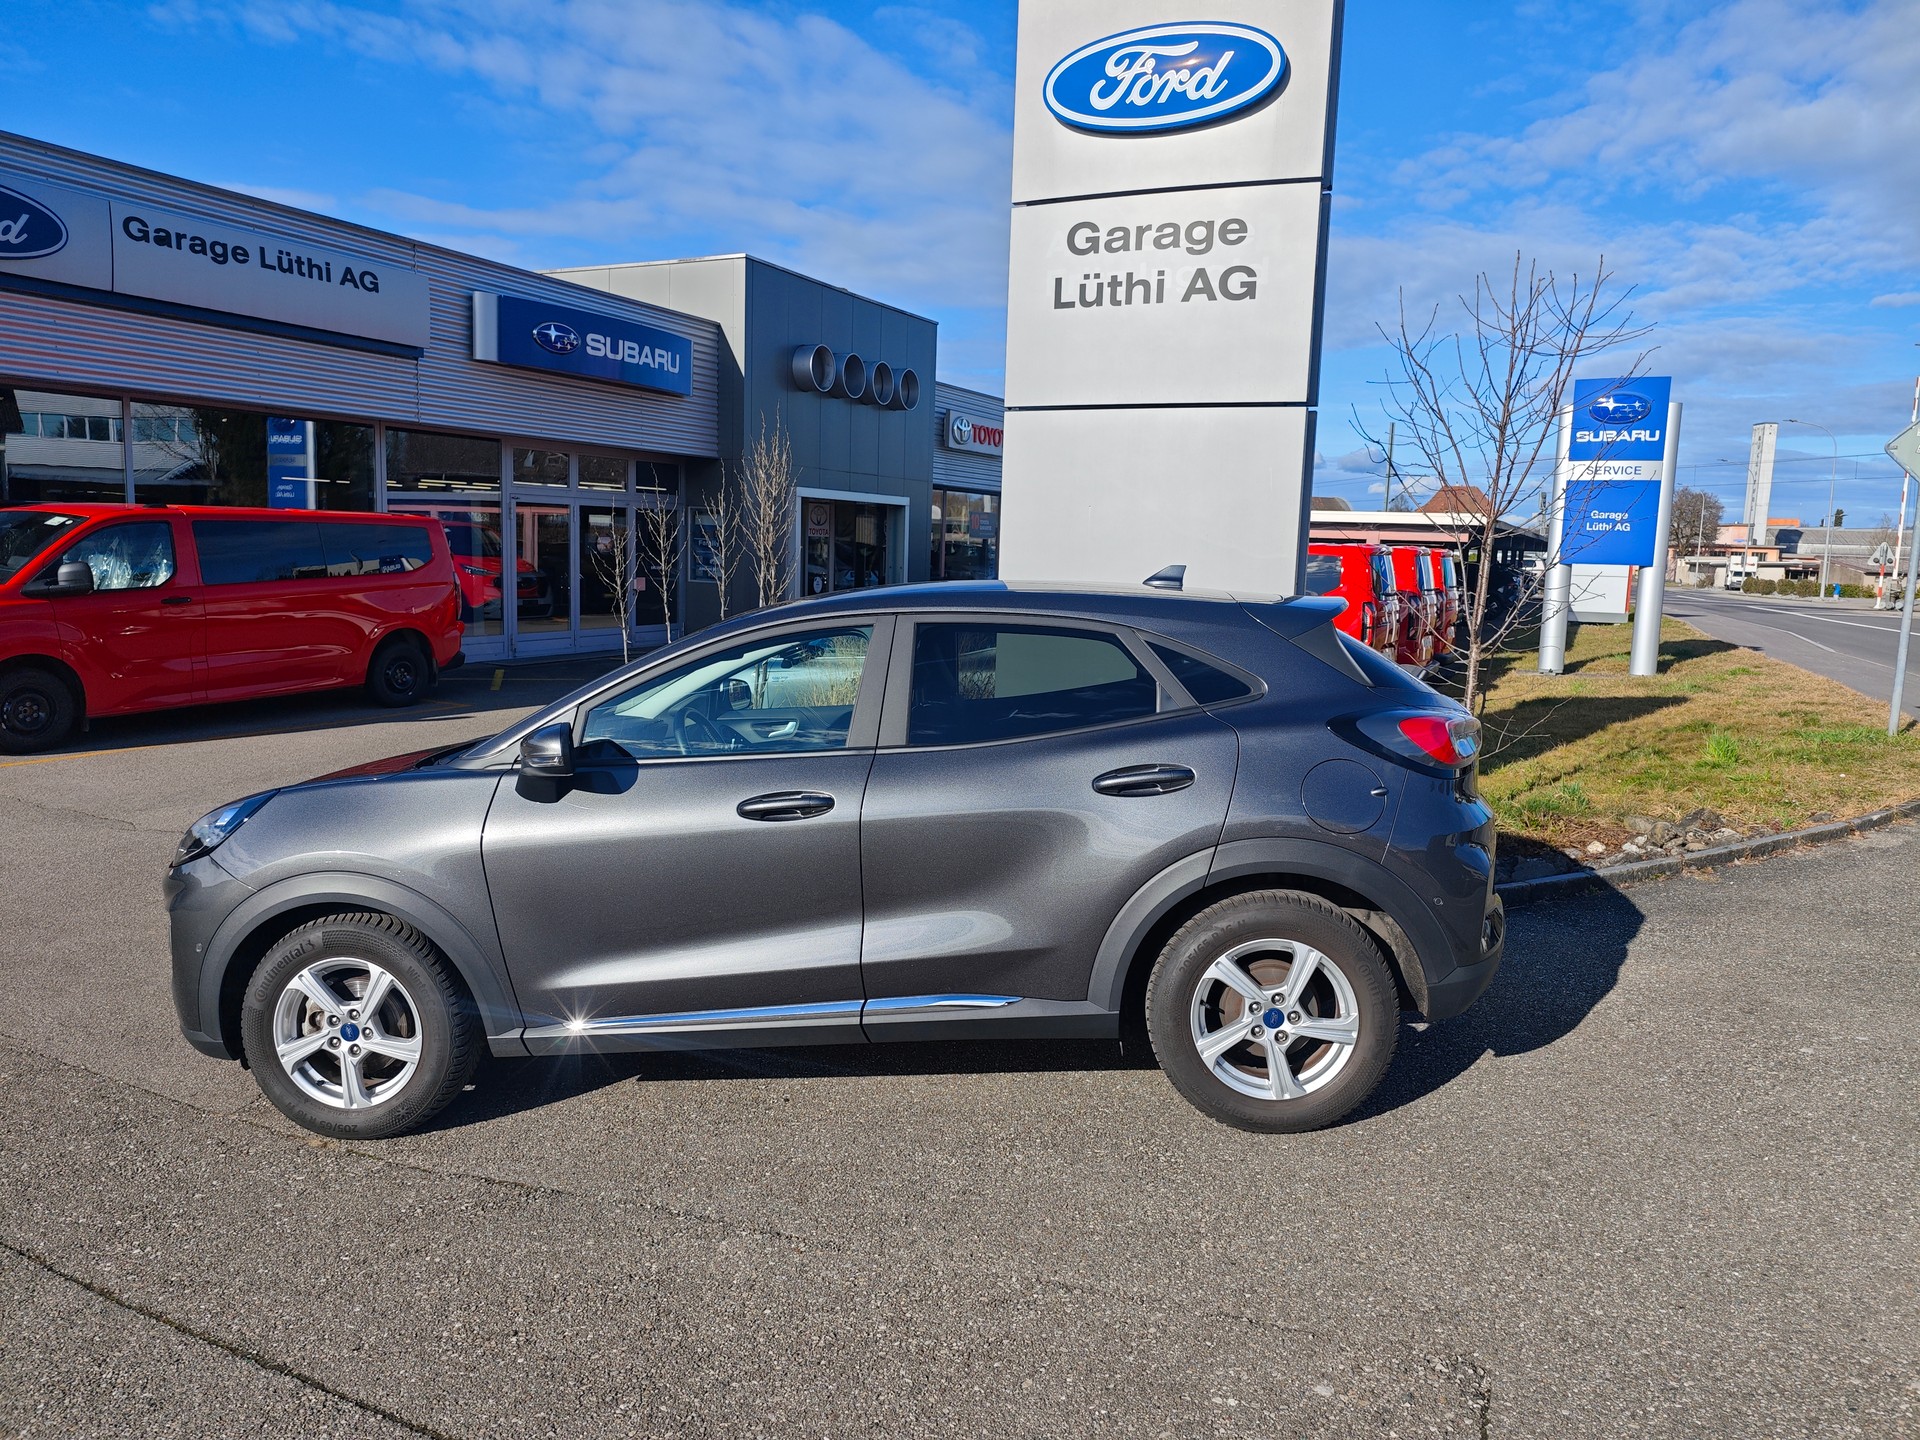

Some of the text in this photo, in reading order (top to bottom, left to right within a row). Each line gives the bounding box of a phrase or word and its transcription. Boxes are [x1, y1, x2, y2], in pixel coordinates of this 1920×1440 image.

[1089, 40, 1235, 111] Ford
[1066, 217, 1248, 256] Garage
[122, 215, 380, 294] Garage Lüthi AG
[1053, 265, 1258, 310] Lüthi AG
[585, 333, 680, 374] SUBARU
[1576, 430, 1660, 442] SUBARU
[1586, 465, 1642, 475] SERVICE
[1590, 510, 1629, 521] Garage
[1615, 523, 1631, 531] AG
[808, 527, 830, 536] TOYOTA
